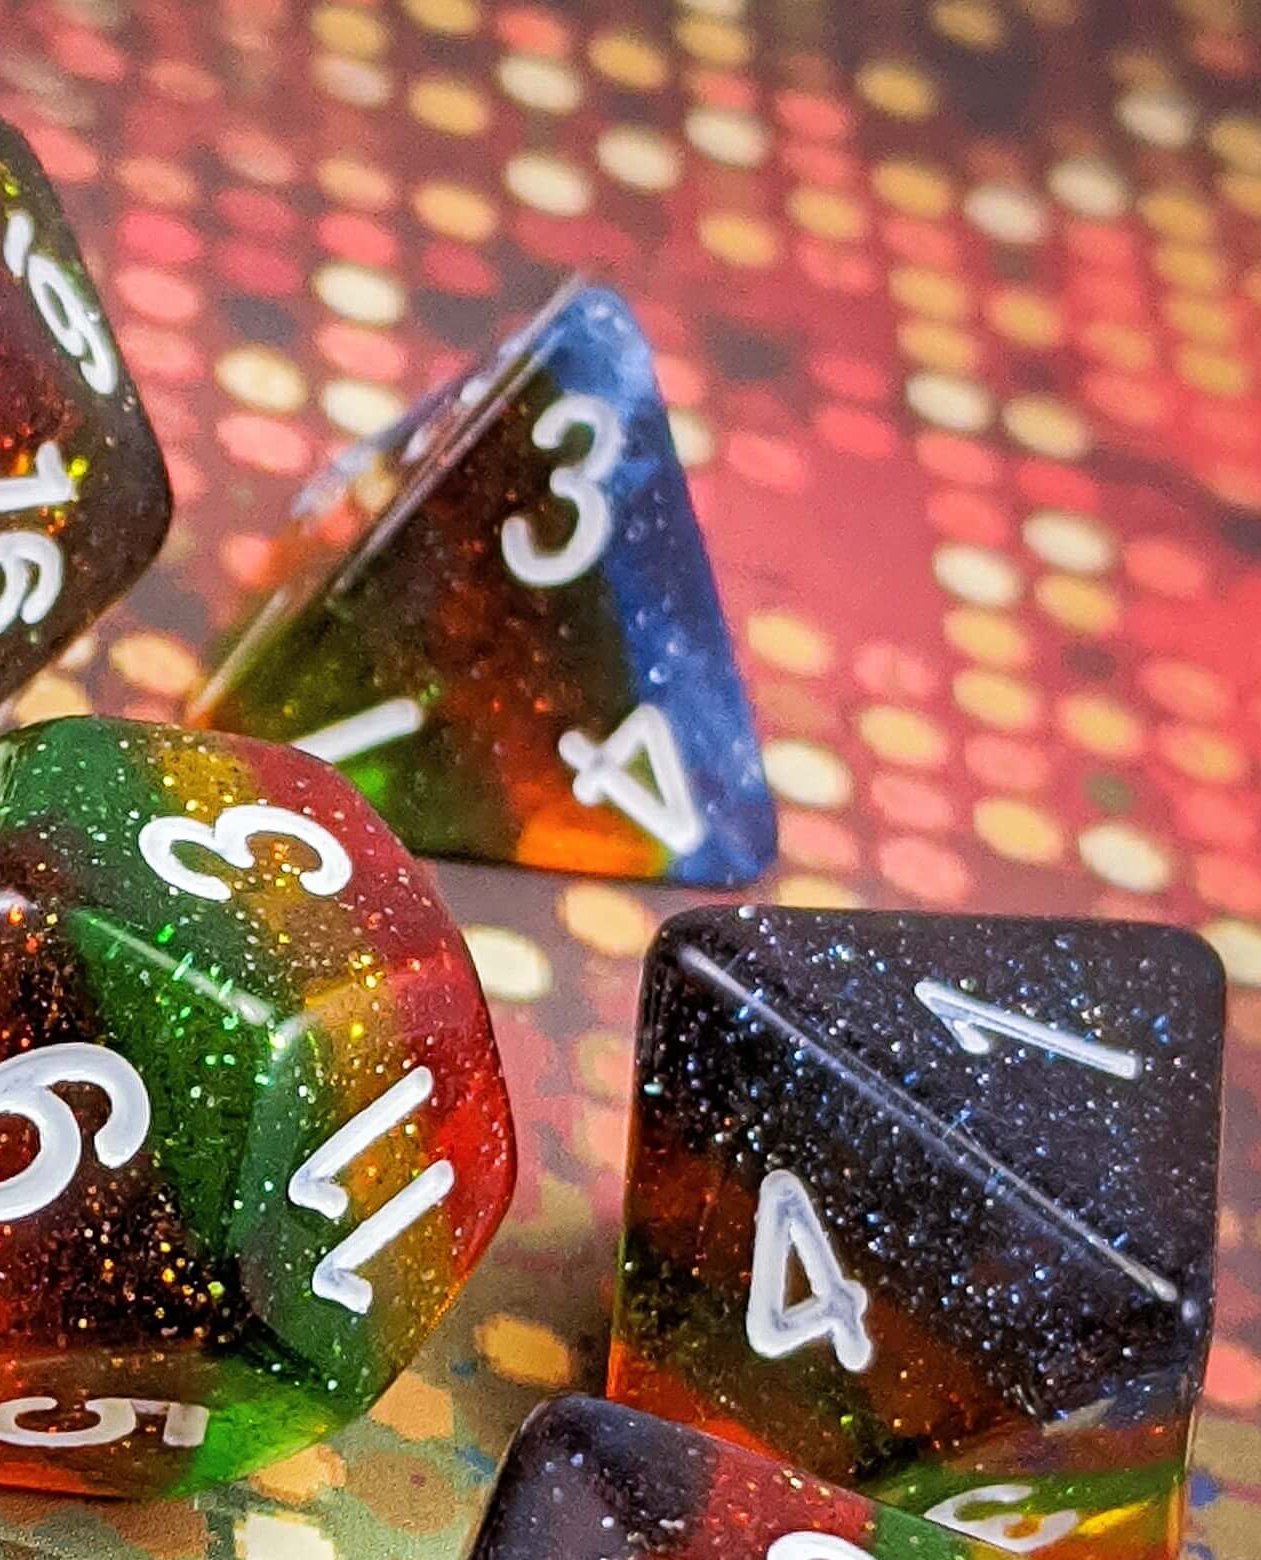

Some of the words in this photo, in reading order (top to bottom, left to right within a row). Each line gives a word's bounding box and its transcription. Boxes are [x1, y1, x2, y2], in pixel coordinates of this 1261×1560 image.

[501, 396, 624, 586] 3
[138, 805, 353, 902] 3
[558, 705, 704, 856] 4
[913, 979, 1140, 1080] 1
[287, 1066, 454, 1314] 11
[746, 1169, 872, 1373] 4
